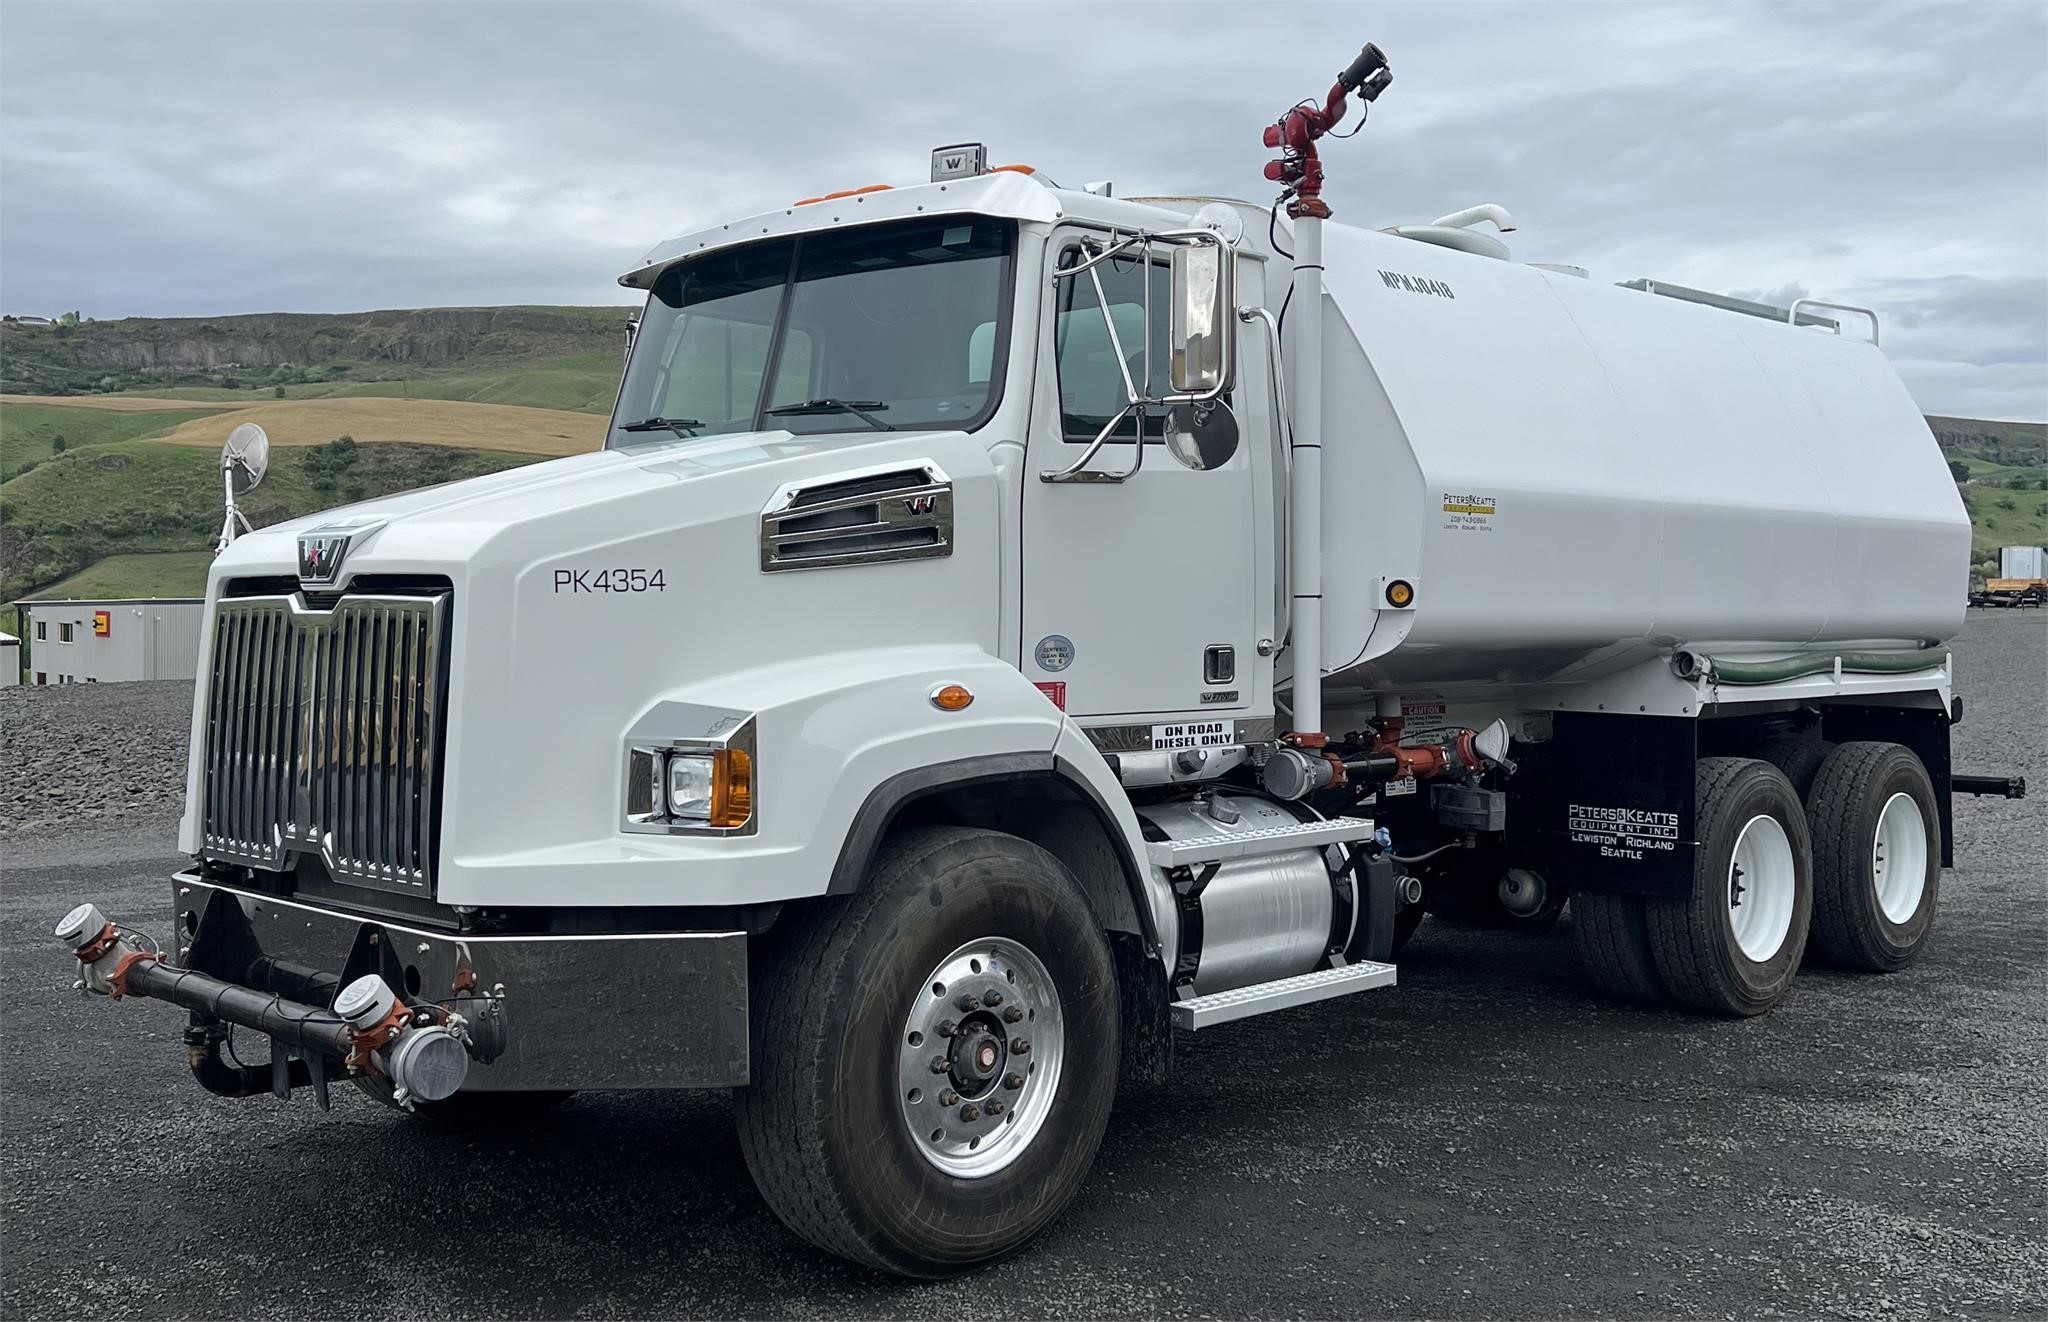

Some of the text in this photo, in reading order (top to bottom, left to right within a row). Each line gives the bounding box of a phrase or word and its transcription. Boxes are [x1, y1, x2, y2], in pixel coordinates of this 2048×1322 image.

[554, 568, 667, 593] PK4354
[1408, 705, 1440, 715] CAUTION
[1165, 723, 1223, 737] ON ROAD
[1154, 734, 1232, 749] DIESEL ONLY
[1573, 820, 1674, 837] EQUIPMENT INC.
[1571, 831, 1675, 850] LEWISTON RICHLAND
[1600, 846, 1643, 860] SEATTLE
